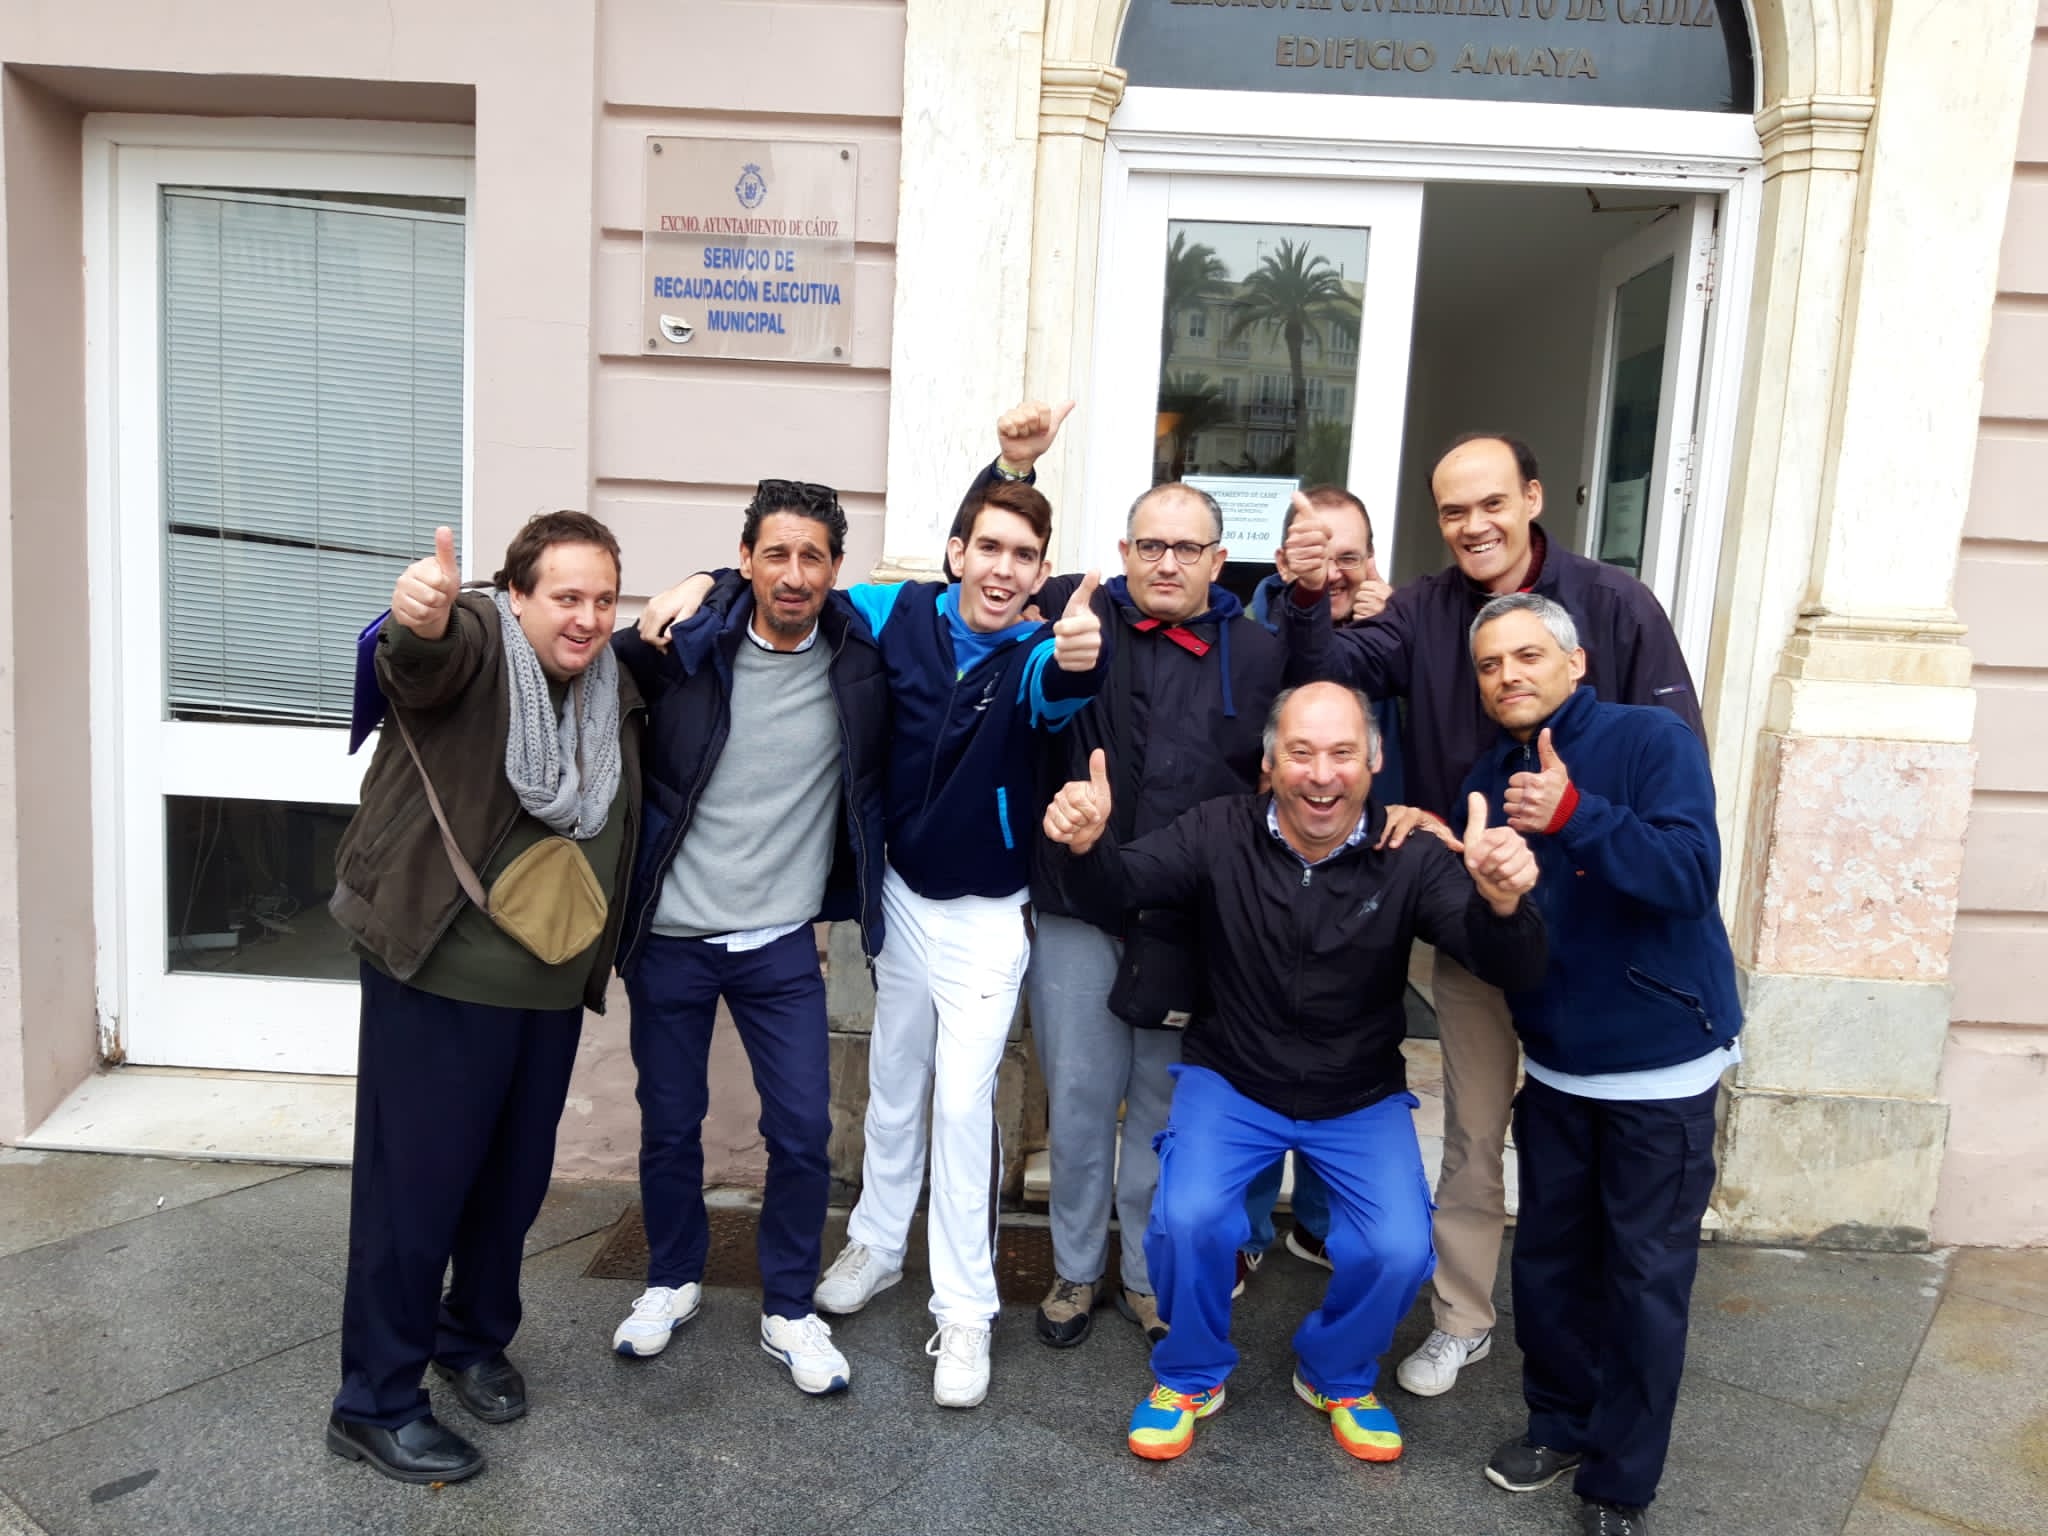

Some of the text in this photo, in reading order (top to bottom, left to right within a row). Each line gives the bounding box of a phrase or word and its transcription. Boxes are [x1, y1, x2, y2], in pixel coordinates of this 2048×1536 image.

[1275, 34, 1599, 79] EDIFICIO AMAYA
[703, 217, 787, 236] AYUNTAMIENTO
[789, 220, 804, 236] DE
[805, 216, 839, 237] CÁDIZ
[704, 247, 794, 272] SERVICIO DE
[654, 275, 841, 305] RECAUDACIÓN EJECUTIVA
[707, 310, 785, 335] MUNICIPAL
